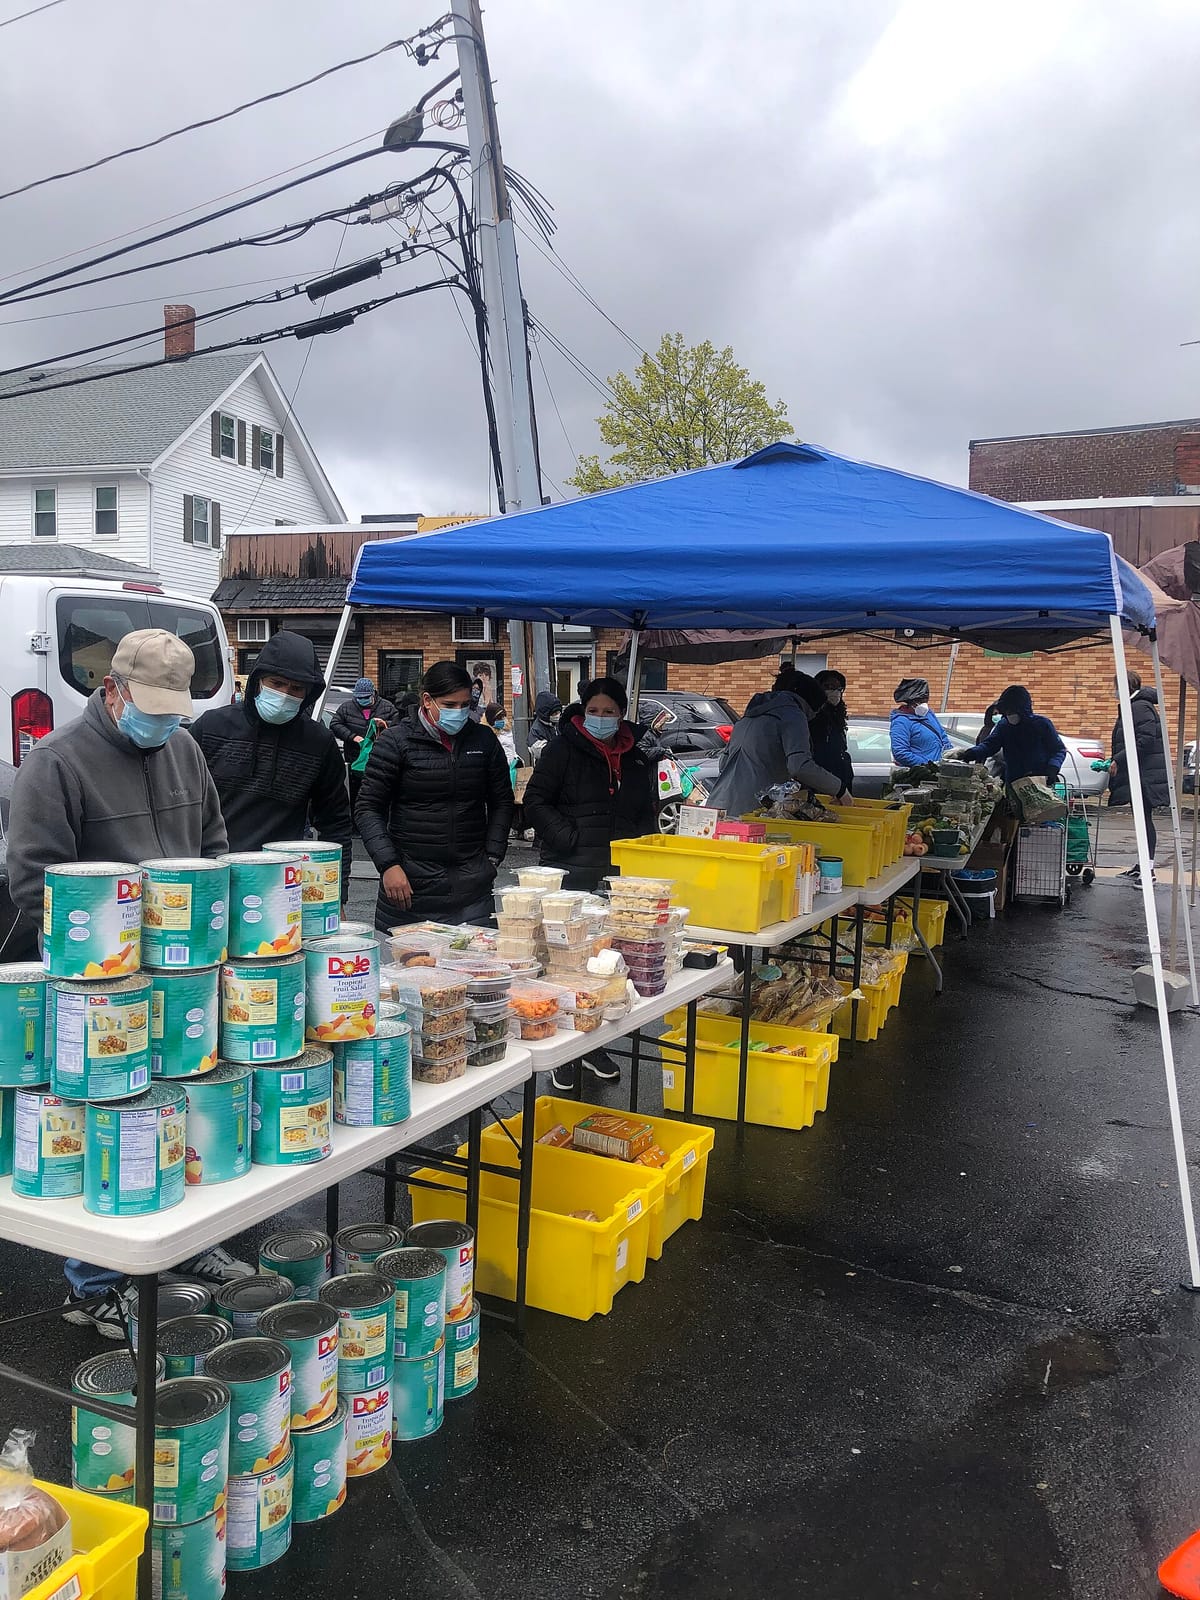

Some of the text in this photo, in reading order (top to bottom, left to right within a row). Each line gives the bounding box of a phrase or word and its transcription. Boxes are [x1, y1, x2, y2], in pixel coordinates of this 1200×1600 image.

[328, 954, 370, 976] Dole
[338, 978, 363, 987] Tropical
[350, 983, 367, 991] Salad
[89, 996, 108, 1005] Dole
[43, 1097, 62, 1106] Dole
[161, 1107, 175, 1117] Dole
[353, 1391, 389, 1414] Dole
[262, 1475, 276, 1486] Dole
